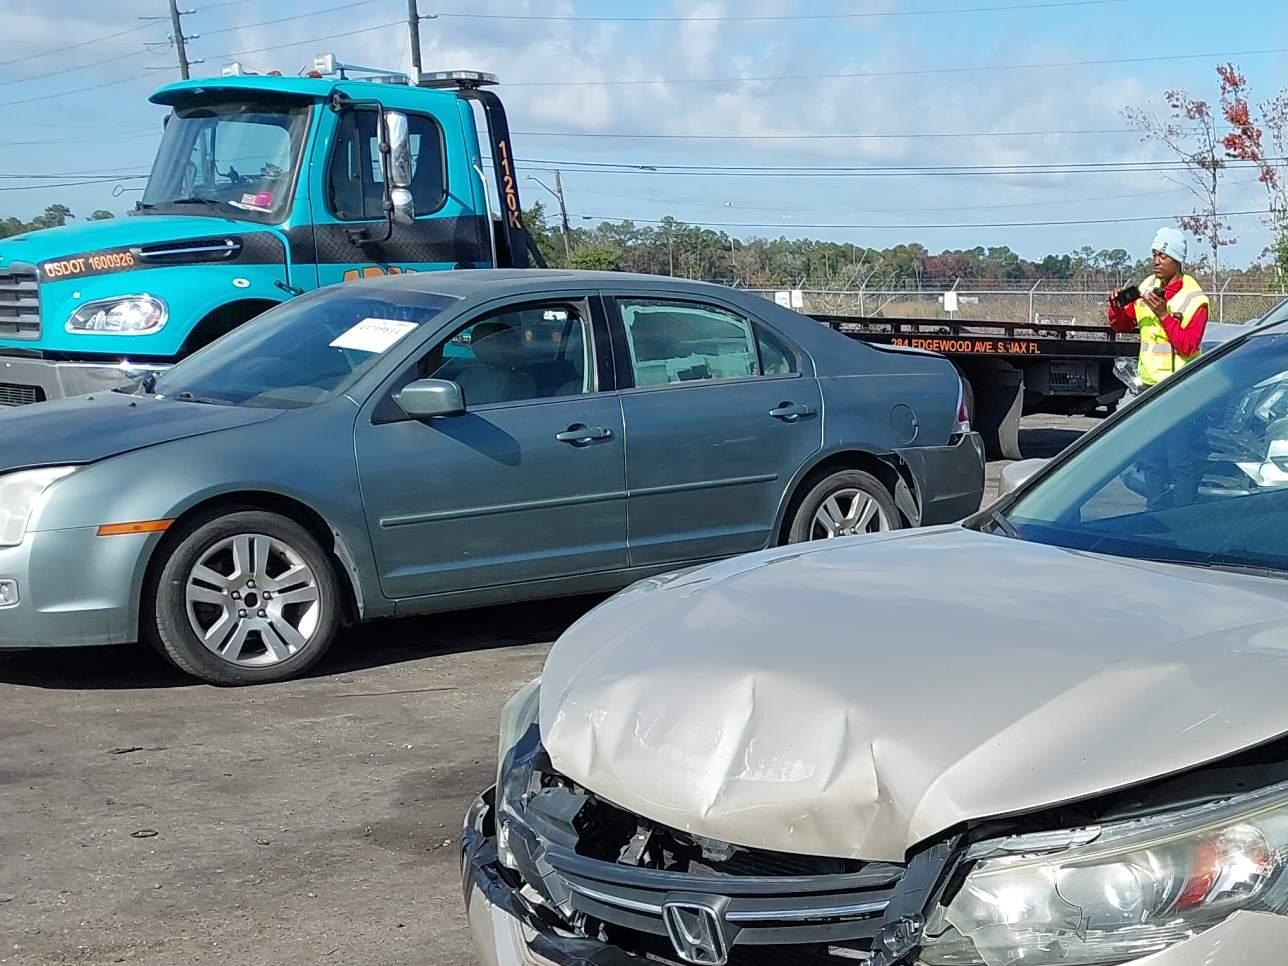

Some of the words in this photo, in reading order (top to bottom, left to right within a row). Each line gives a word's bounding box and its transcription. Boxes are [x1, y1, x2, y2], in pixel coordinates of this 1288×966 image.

[498, 140, 522, 229] 1120K
[44, 259, 86, 277] USDOT
[88, 252, 134, 271] 1600926
[911, 339, 972, 352] EDGEWOOD
[1029, 342, 1041, 354] FL
